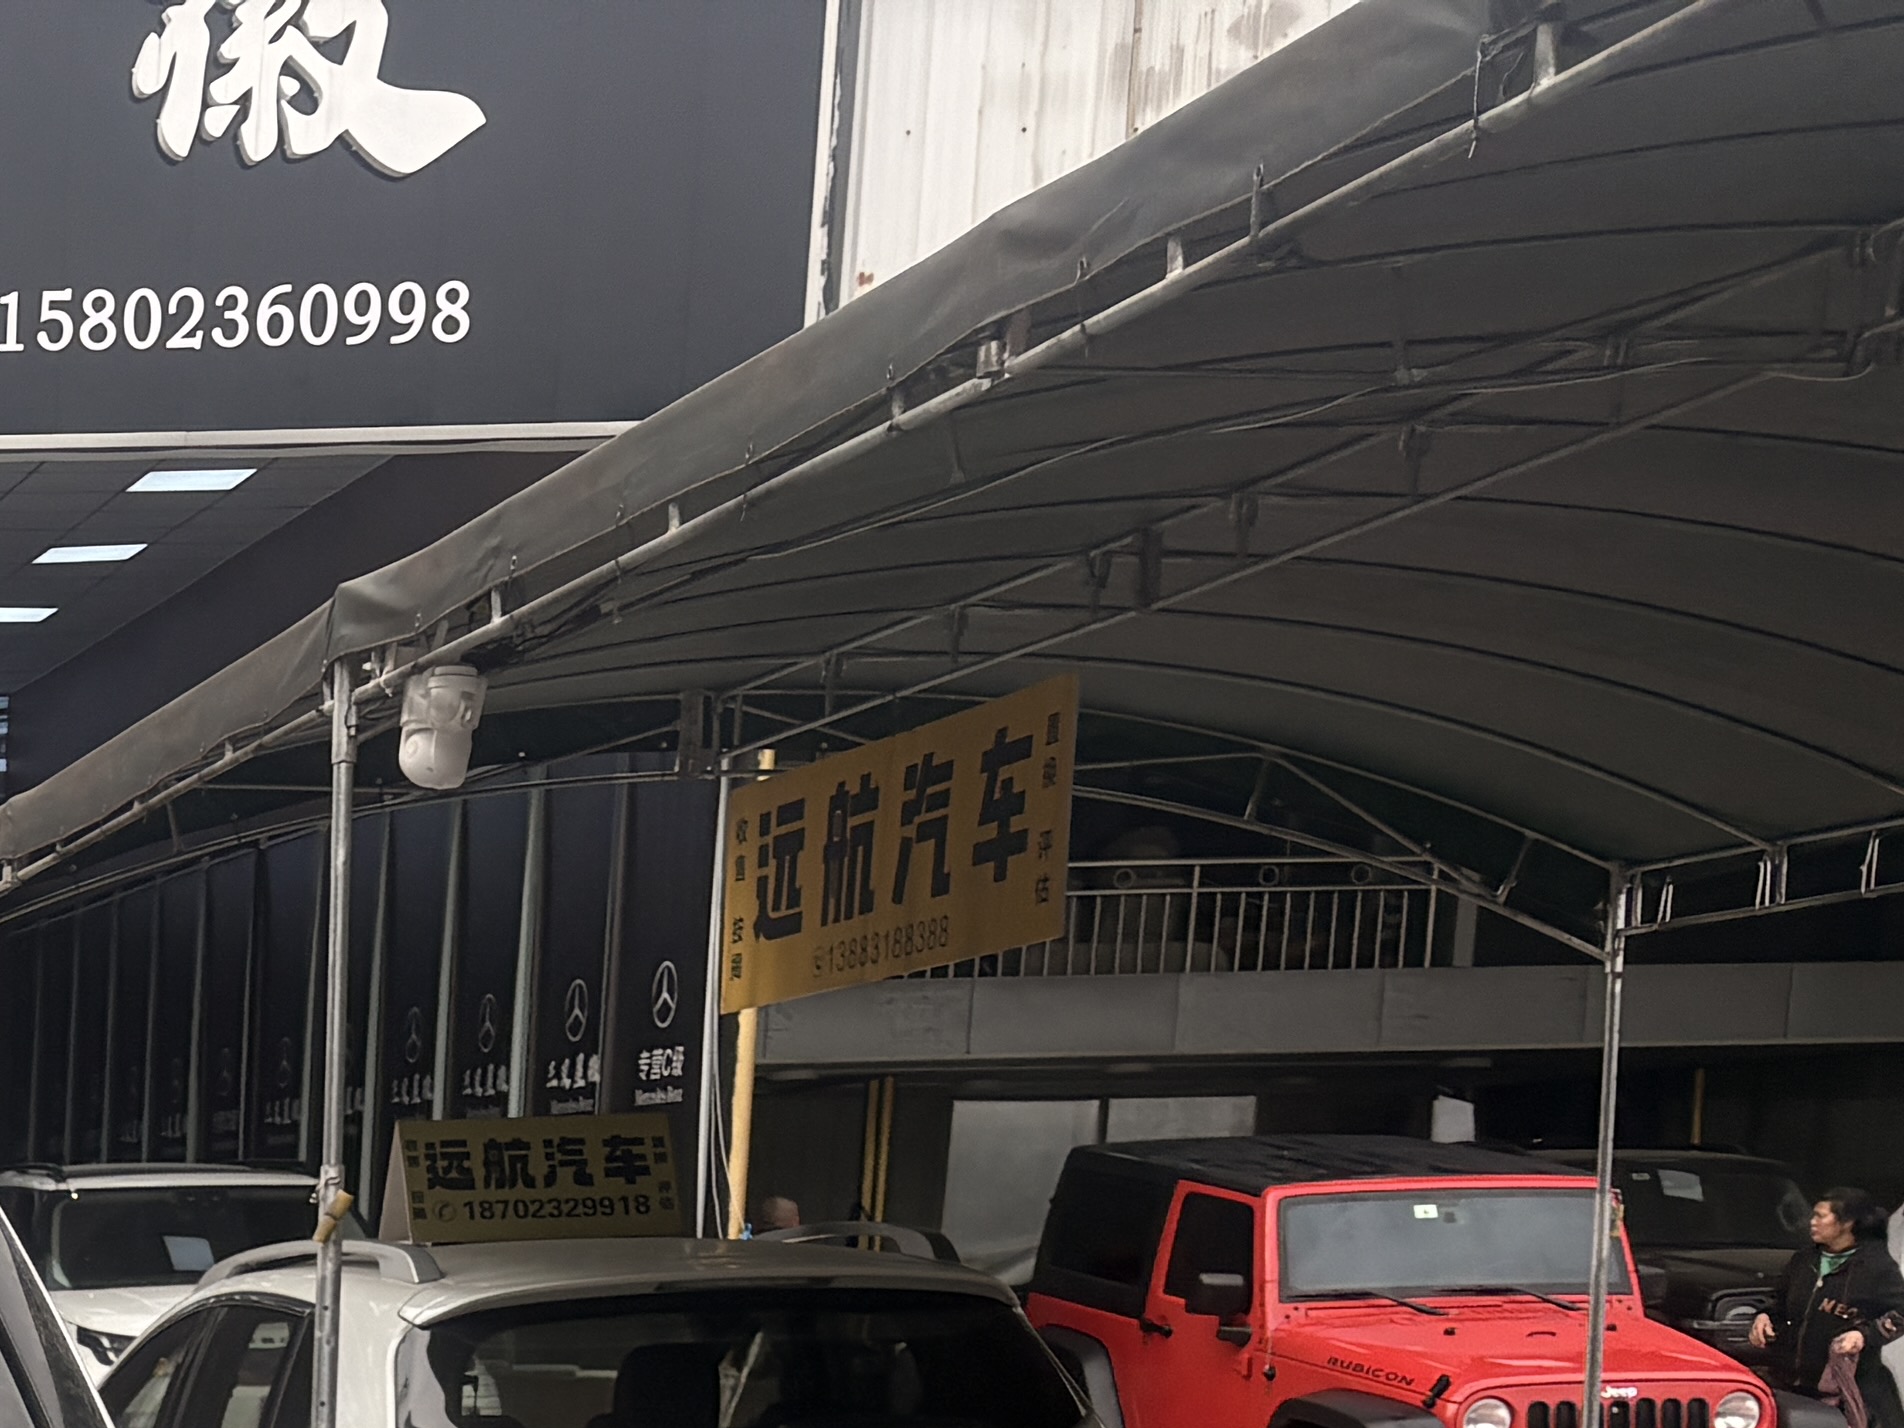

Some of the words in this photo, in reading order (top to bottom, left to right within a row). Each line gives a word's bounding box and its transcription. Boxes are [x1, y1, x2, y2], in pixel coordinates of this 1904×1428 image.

[753, 727, 1034, 941] 远航汽车
[424, 1134, 652, 1191] 远航汽车
[463, 1194, 652, 1221] 18702329918
[1327, 1356, 1415, 1386] RUBICON
[1600, 1384, 1638, 1399] Jeep
